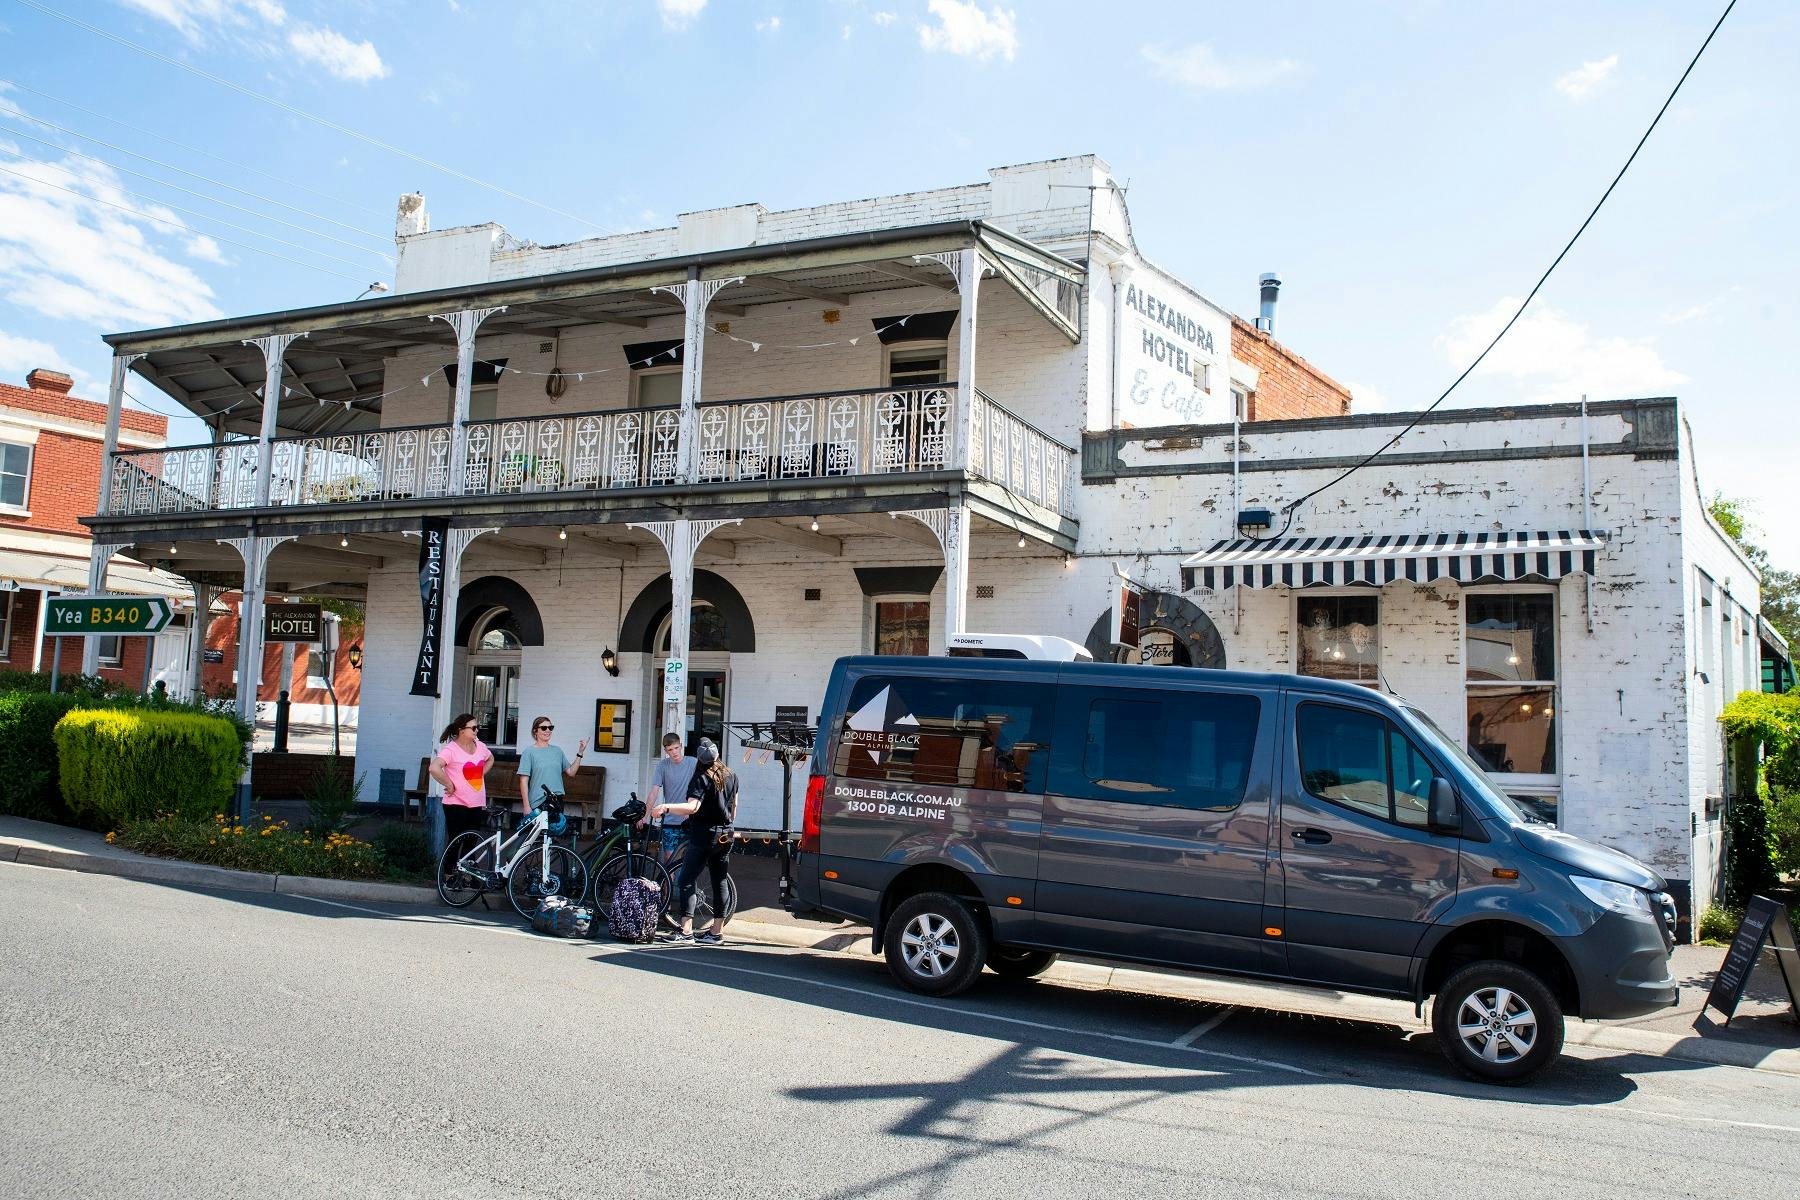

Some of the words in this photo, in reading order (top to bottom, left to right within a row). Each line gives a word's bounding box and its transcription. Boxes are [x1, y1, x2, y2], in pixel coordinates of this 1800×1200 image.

[1125, 282, 1214, 355] ALEXANDRA
[1142, 328, 1193, 378] HOTEL
[1129, 368, 1154, 405] &
[55, 607, 82, 624] Yea
[90, 607, 139, 624] B340
[420, 530, 441, 685] RESTAURANT
[271, 620, 316, 633] HOTEL
[1140, 642, 1174, 662] Store
[667, 662, 683, 673] 2P
[844, 731, 884, 742] DOUBLE
[887, 734, 921, 745] BLACK
[834, 786, 962, 807] DOUBLEBLACK.COM.AU
[847, 800, 876, 813] 1300
[878, 804, 896, 815] DB
[898, 805, 946, 820] ALPINE
